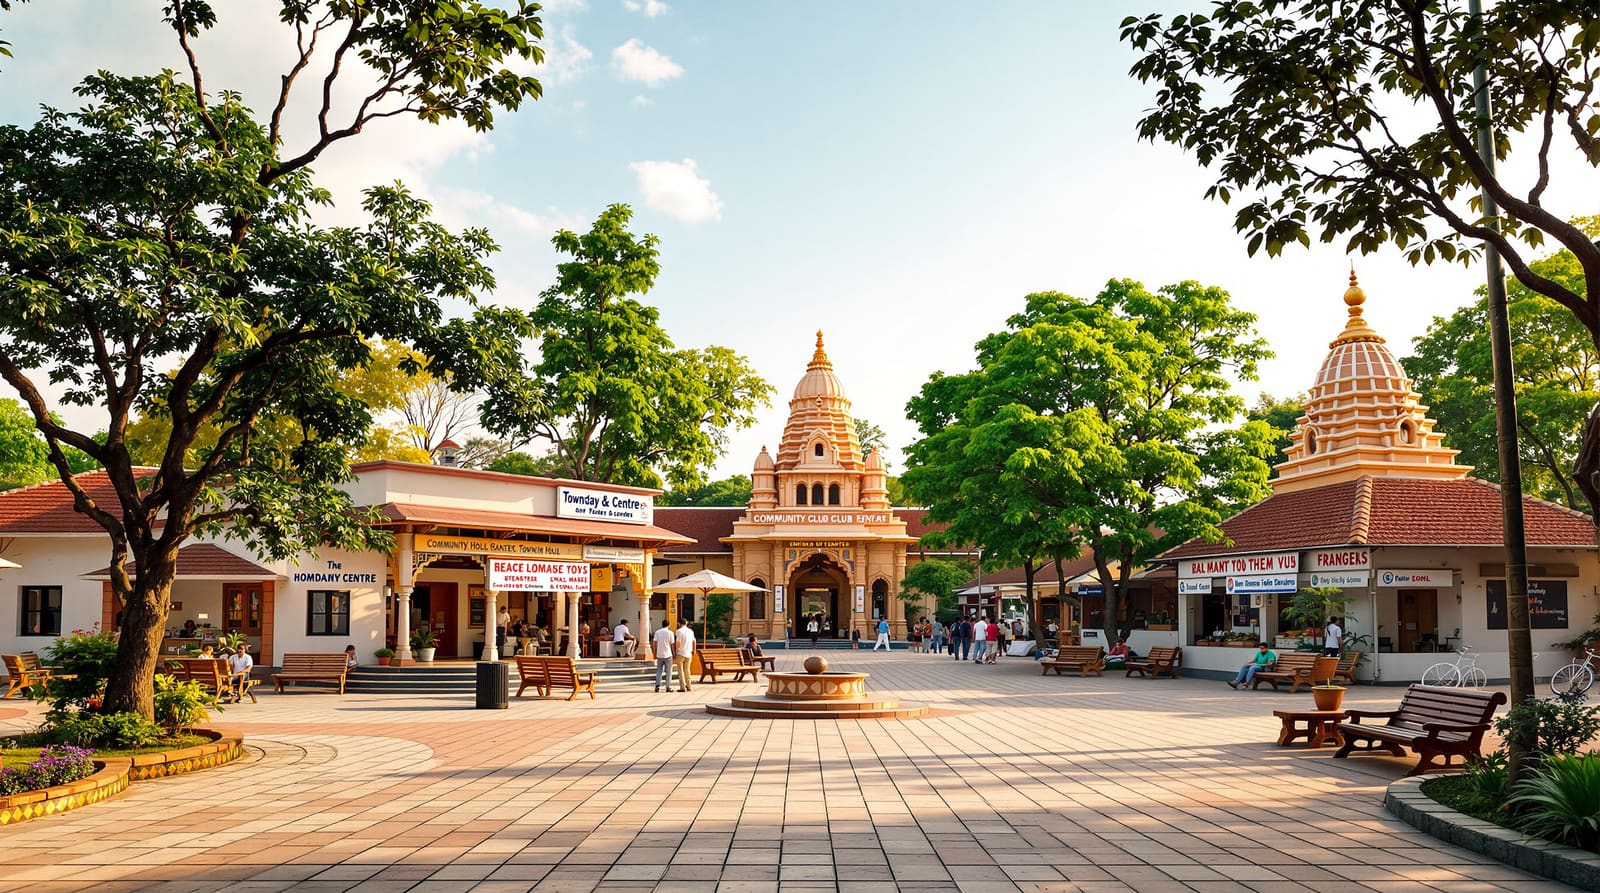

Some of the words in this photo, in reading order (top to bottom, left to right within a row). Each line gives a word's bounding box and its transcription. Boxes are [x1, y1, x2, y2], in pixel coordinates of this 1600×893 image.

[563, 491, 600, 508] Townday
[602, 495, 609, 507] &
[612, 496, 640, 509] Centre
[753, 514, 805, 523] COMMUNITY
[1248, 557, 1273, 571] THEM
[566, 565, 588, 575] TOYS
[343, 574, 376, 582] CENTRE
